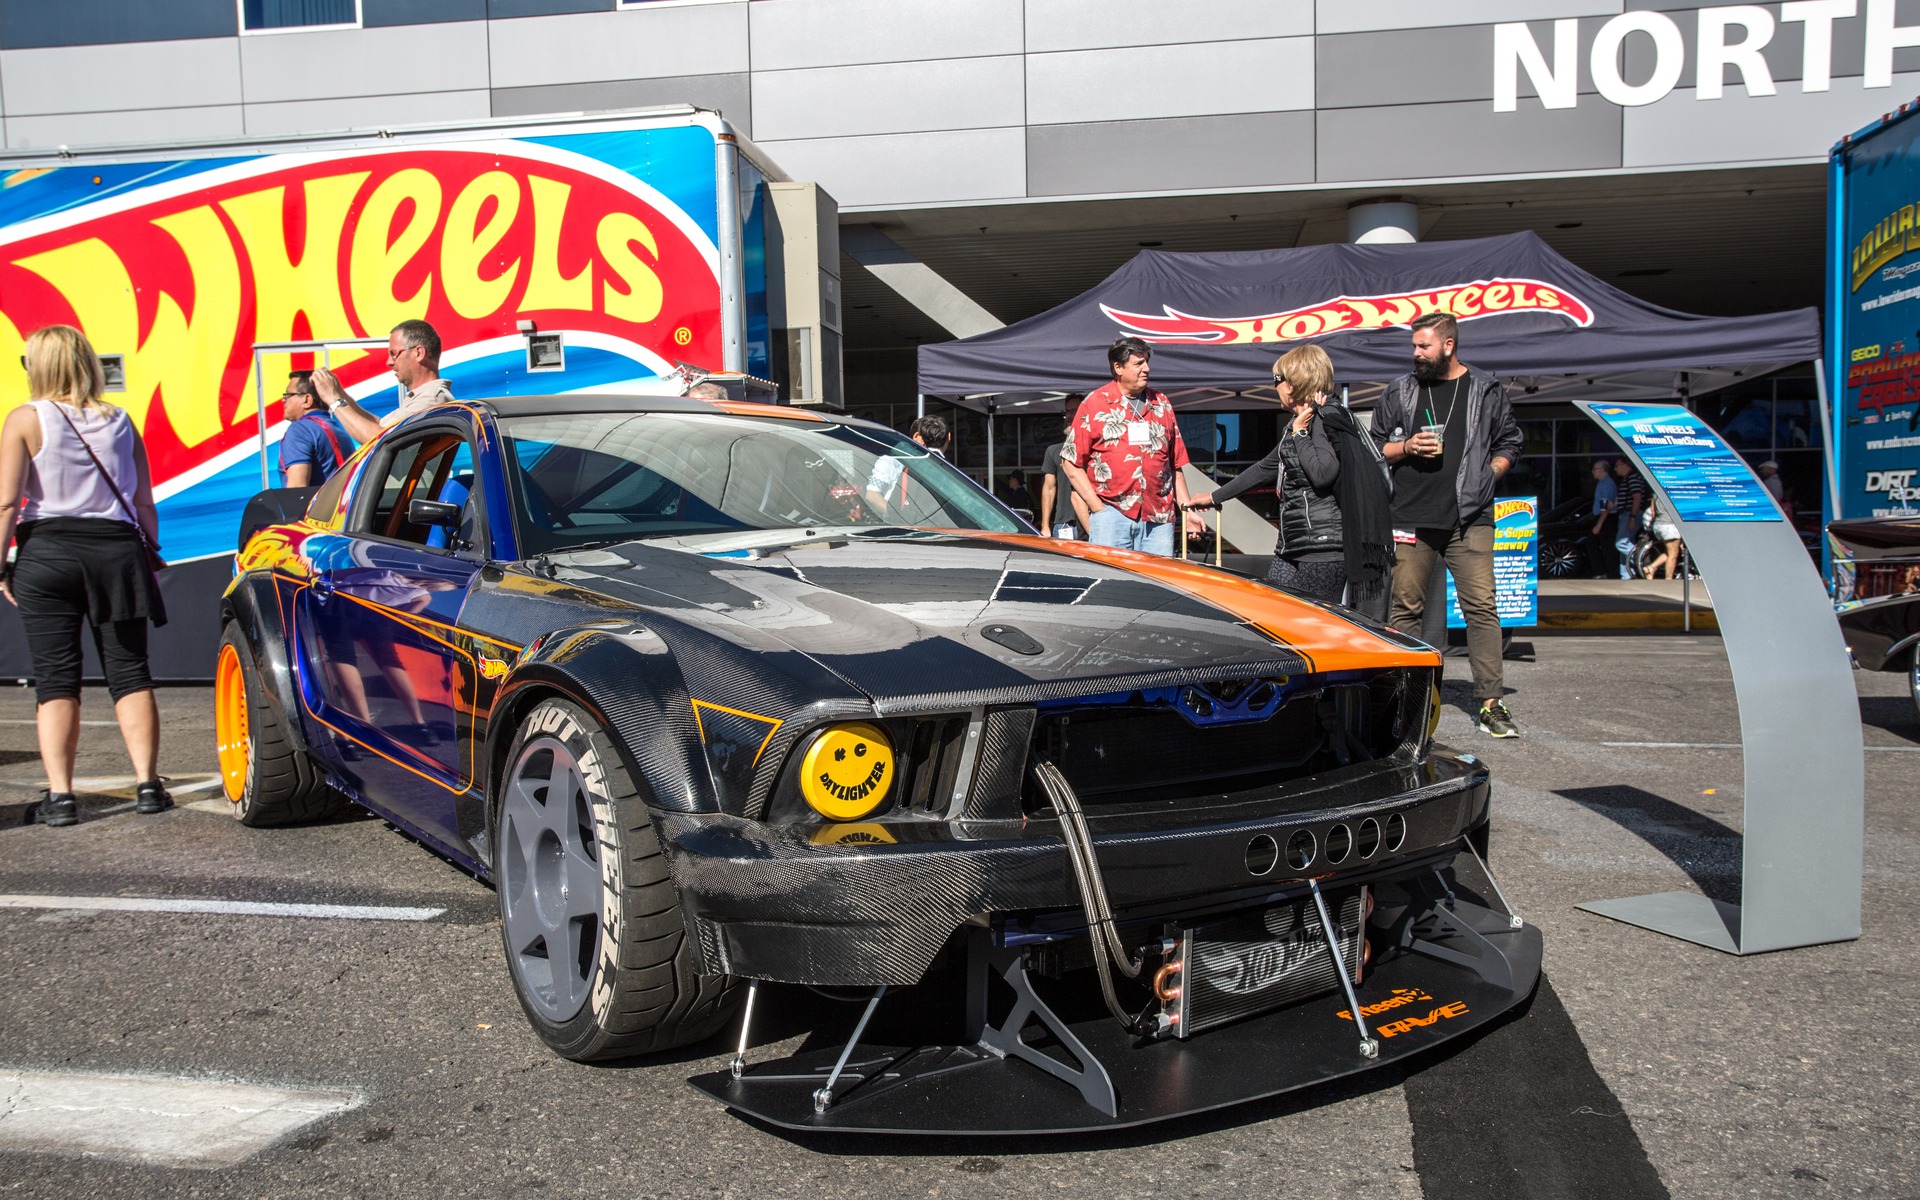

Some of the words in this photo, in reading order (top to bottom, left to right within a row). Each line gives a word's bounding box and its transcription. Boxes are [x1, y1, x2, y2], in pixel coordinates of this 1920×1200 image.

[1492, 0, 1920, 113] NORTH
[1208, 309, 1353, 345] HOT
[1851, 344, 1880, 362] GEICO
[1632, 423, 1655, 433] HOT
[1654, 424, 1696, 435] WHEELS
[1632, 434, 1716, 449] #NameThatStang
[1865, 470, 1917, 492] DIRT
[1505, 527, 1536, 540] Super
[1493, 541, 1529, 552] aceway
[524, 706, 582, 742] HOT
[820, 761, 886, 801] DAYLIGHTER
[577, 748, 622, 1028] WHEELS
